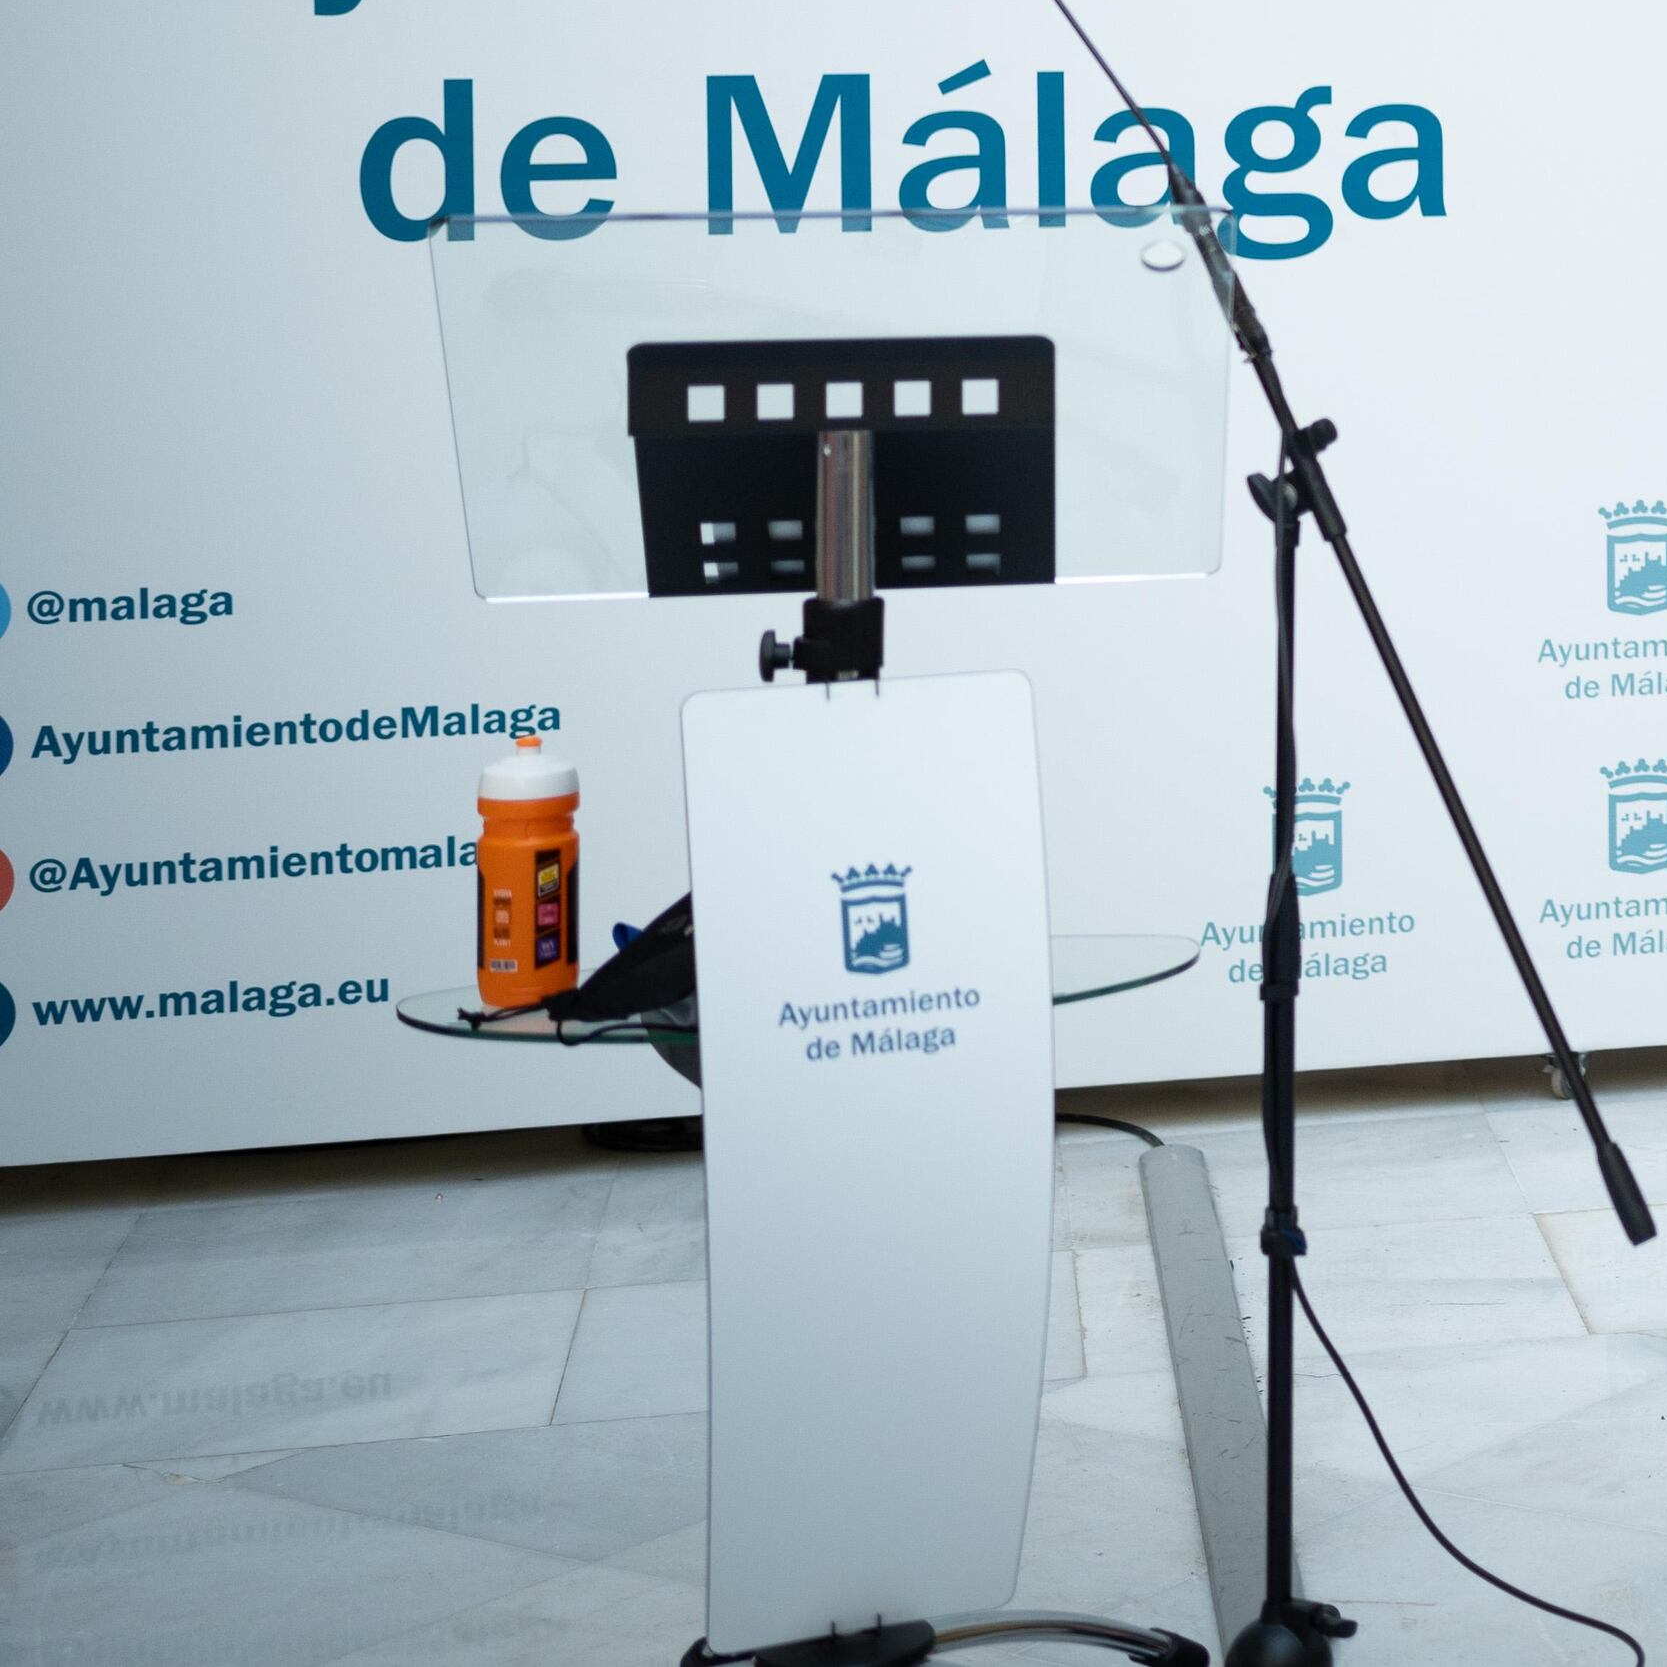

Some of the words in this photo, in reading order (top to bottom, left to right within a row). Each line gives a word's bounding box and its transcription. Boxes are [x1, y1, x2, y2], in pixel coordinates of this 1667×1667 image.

[360, 79, 617, 242] de
[706, 60, 1446, 260] Málaga
[26, 587, 233, 626] @malaga
[1565, 675, 1601, 699] de
[31, 703, 561, 765] AyuntamientodeMalaga
[29, 835, 478, 894] @Ayuntamientomala
[1566, 934, 1601, 958] de
[1229, 959, 1263, 983] de
[1303, 952, 1387, 980] álaga
[32, 978, 389, 1026] www.malaga.eu
[778, 988, 980, 1031] Ayuntamiento
[806, 1037, 840, 1061] de
[852, 1027, 956, 1055] Málaga
